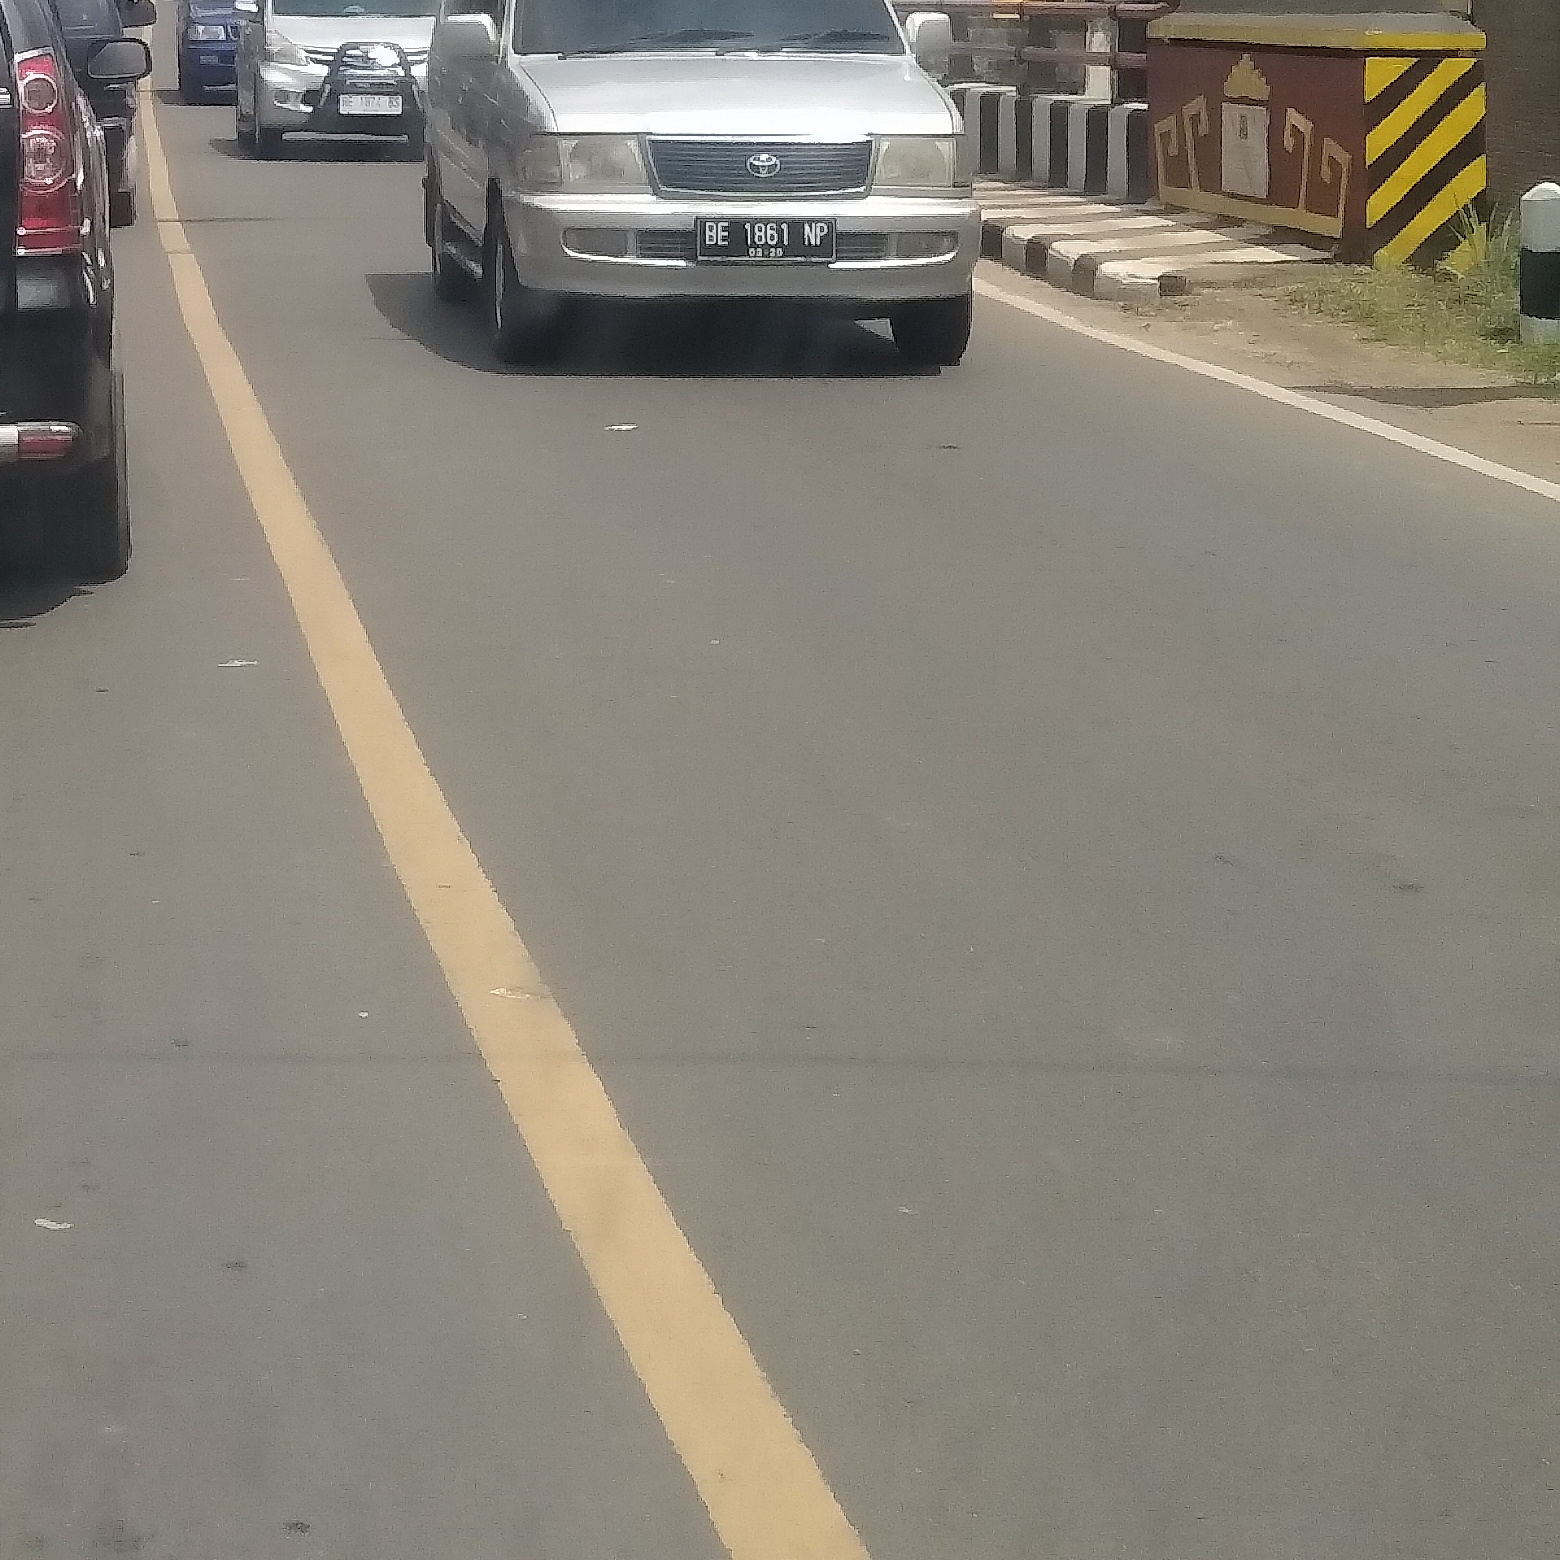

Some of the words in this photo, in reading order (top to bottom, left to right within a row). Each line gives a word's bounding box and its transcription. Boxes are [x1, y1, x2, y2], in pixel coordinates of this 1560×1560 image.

[705, 221, 729, 246] BE
[744, 222, 789, 246] 1861
[803, 222, 829, 246] NP
